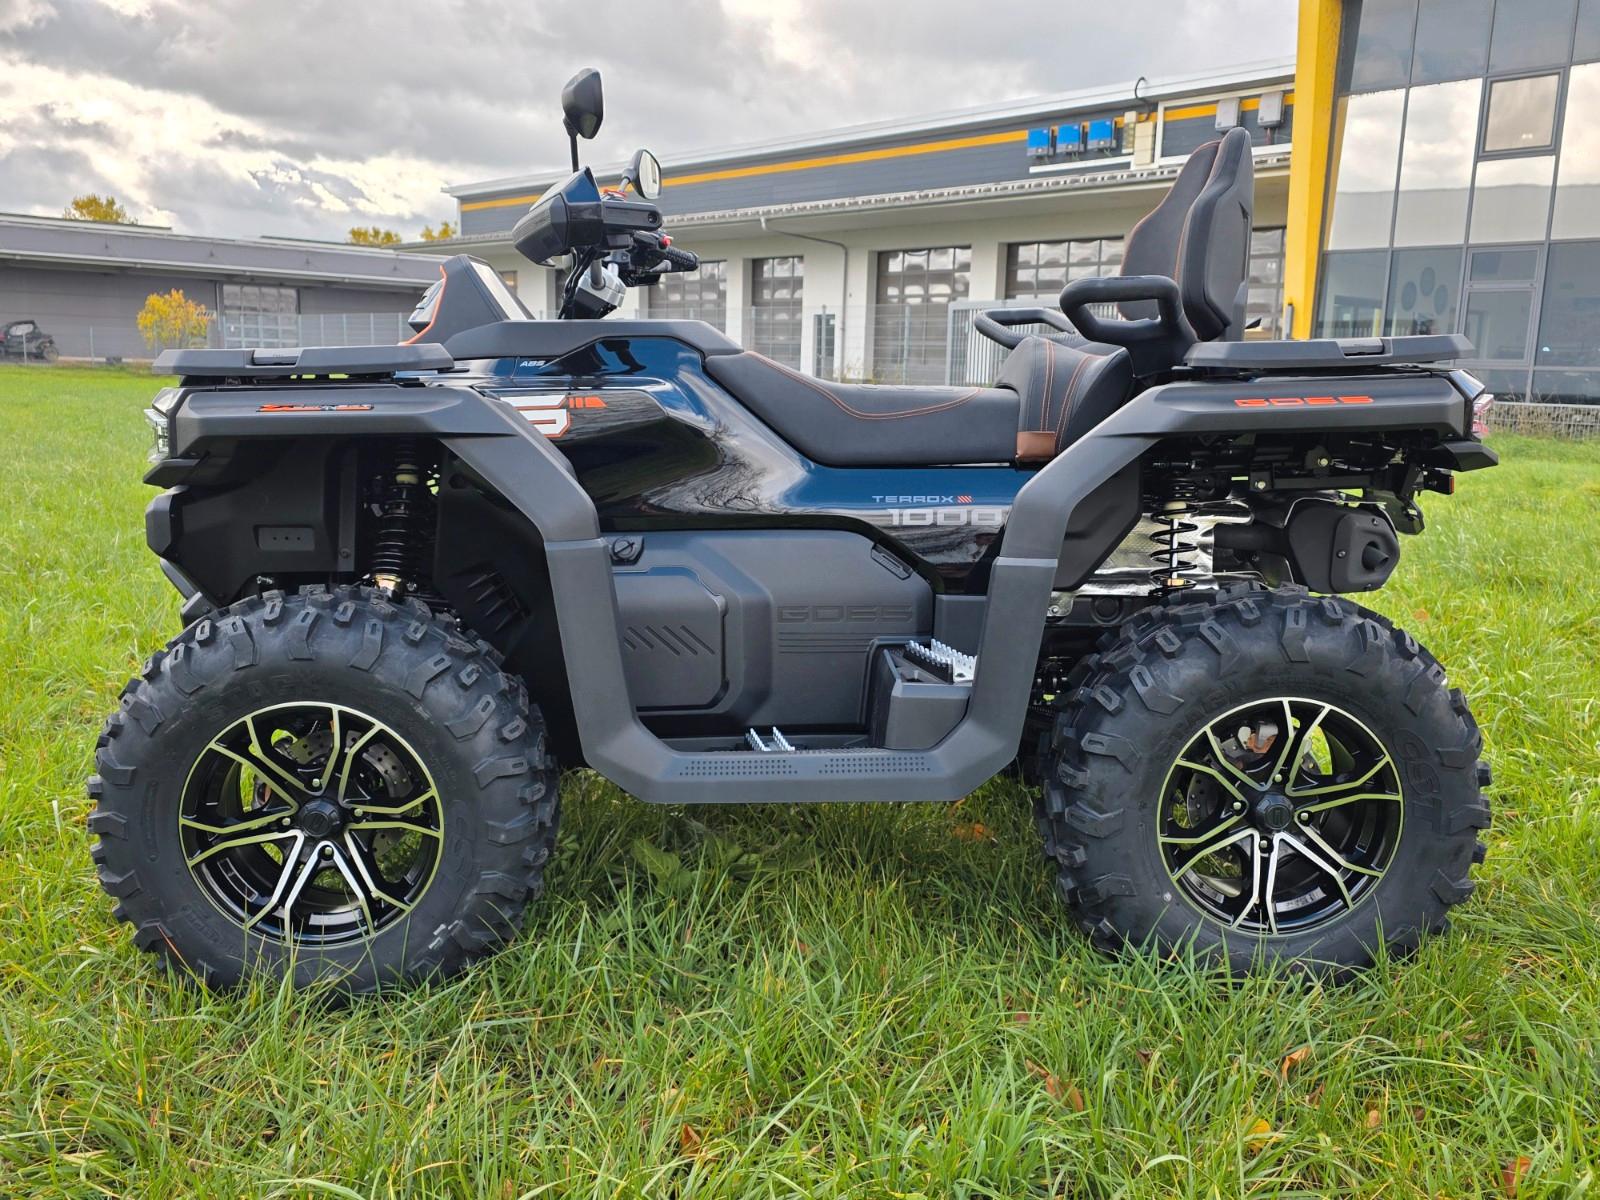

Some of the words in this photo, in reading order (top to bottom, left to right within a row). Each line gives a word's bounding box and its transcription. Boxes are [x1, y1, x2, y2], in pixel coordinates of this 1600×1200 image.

[1234, 396, 1375, 407] GOES
[872, 495, 954, 503] TERROX
[887, 508, 1002, 526] 1000
[777, 605, 913, 623] GOES
[1392, 728, 1442, 834] CST
